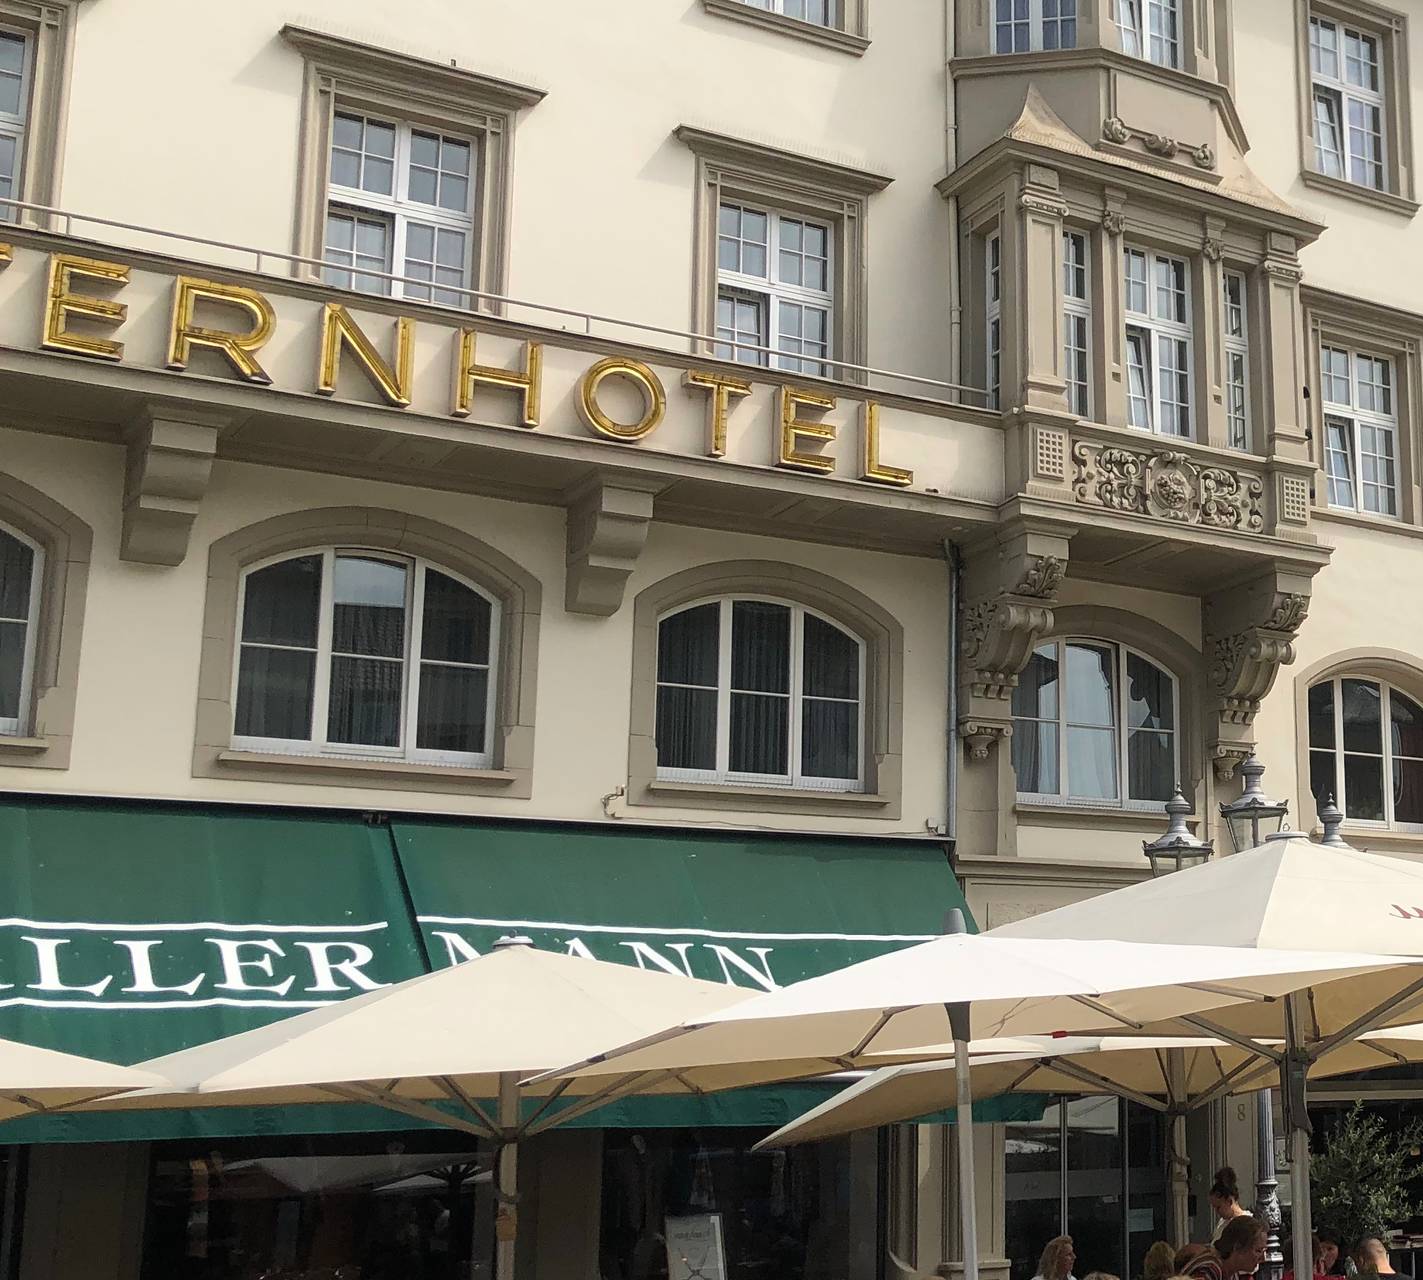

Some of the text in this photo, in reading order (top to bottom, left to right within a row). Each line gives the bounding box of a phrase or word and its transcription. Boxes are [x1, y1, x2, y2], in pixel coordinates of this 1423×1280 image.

[0, 242, 914, 487] ERNHOTEL
[0, 936, 393, 996] LLER
[1237, 1103, 1246, 1121] 8
